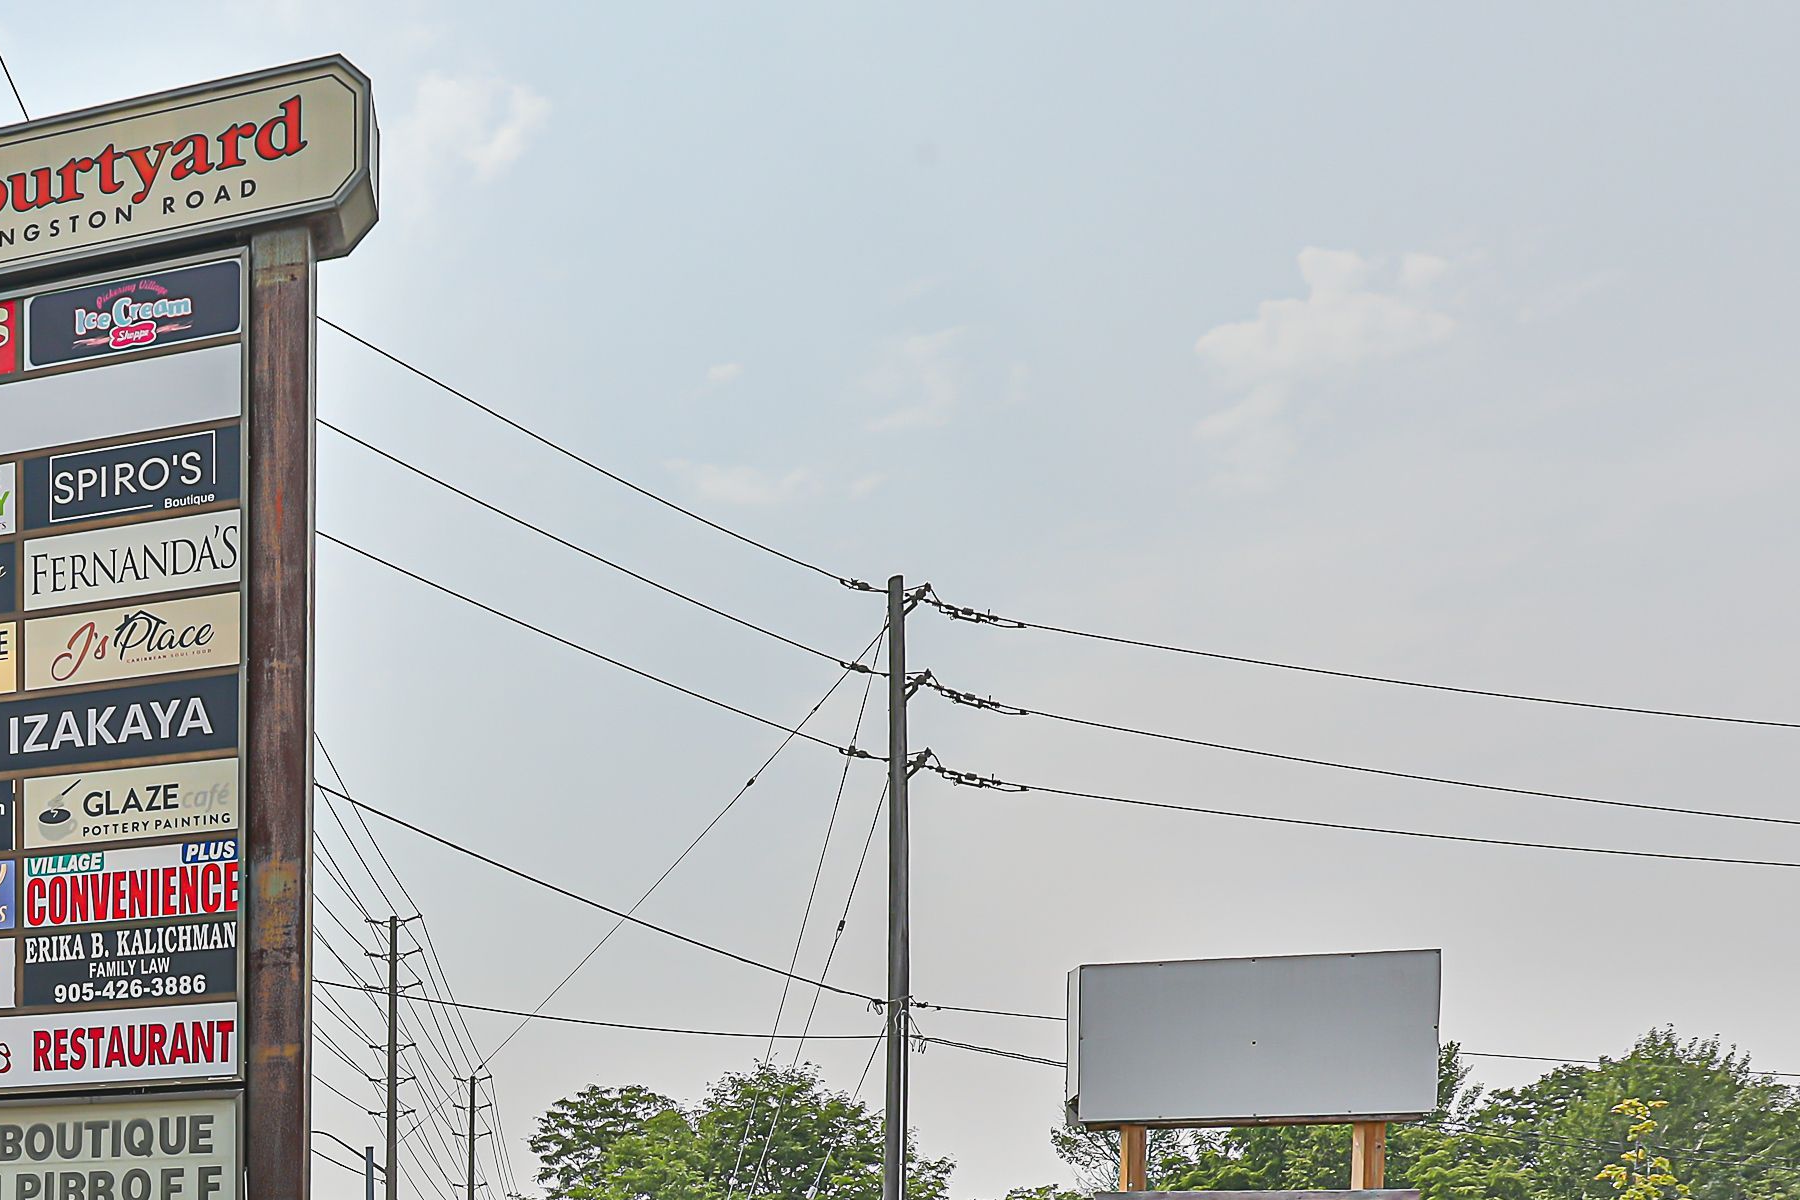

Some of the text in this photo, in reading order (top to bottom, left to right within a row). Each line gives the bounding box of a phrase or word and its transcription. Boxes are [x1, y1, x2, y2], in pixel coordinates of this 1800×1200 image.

[162, 178, 259, 214] ROAD
[96, 279, 169, 309] Pickering Village
[74, 297, 193, 336] Ice Cream
[117, 329, 150, 342] Shoppe
[52, 450, 203, 506] SPIRO'S
[163, 491, 216, 511] Boutique
[30, 524, 239, 598] FERNANDA'S
[50, 612, 216, 682] J's Place
[8, 696, 214, 755] IZAKAYA
[82, 782, 232, 818] GLAZE café
[82, 812, 232, 838] POTTERY PAINTING
[28, 840, 236, 875] VILLAGE PLUS
[26, 860, 238, 928] CONVENIENCE
[25, 920, 237, 964] ERIKA B. KALICHMAN
[88, 957, 171, 979] FAMILY LAW
[53, 974, 207, 1004] 905-426-3886
[32, 1019, 235, 1073] RESTAURANT
